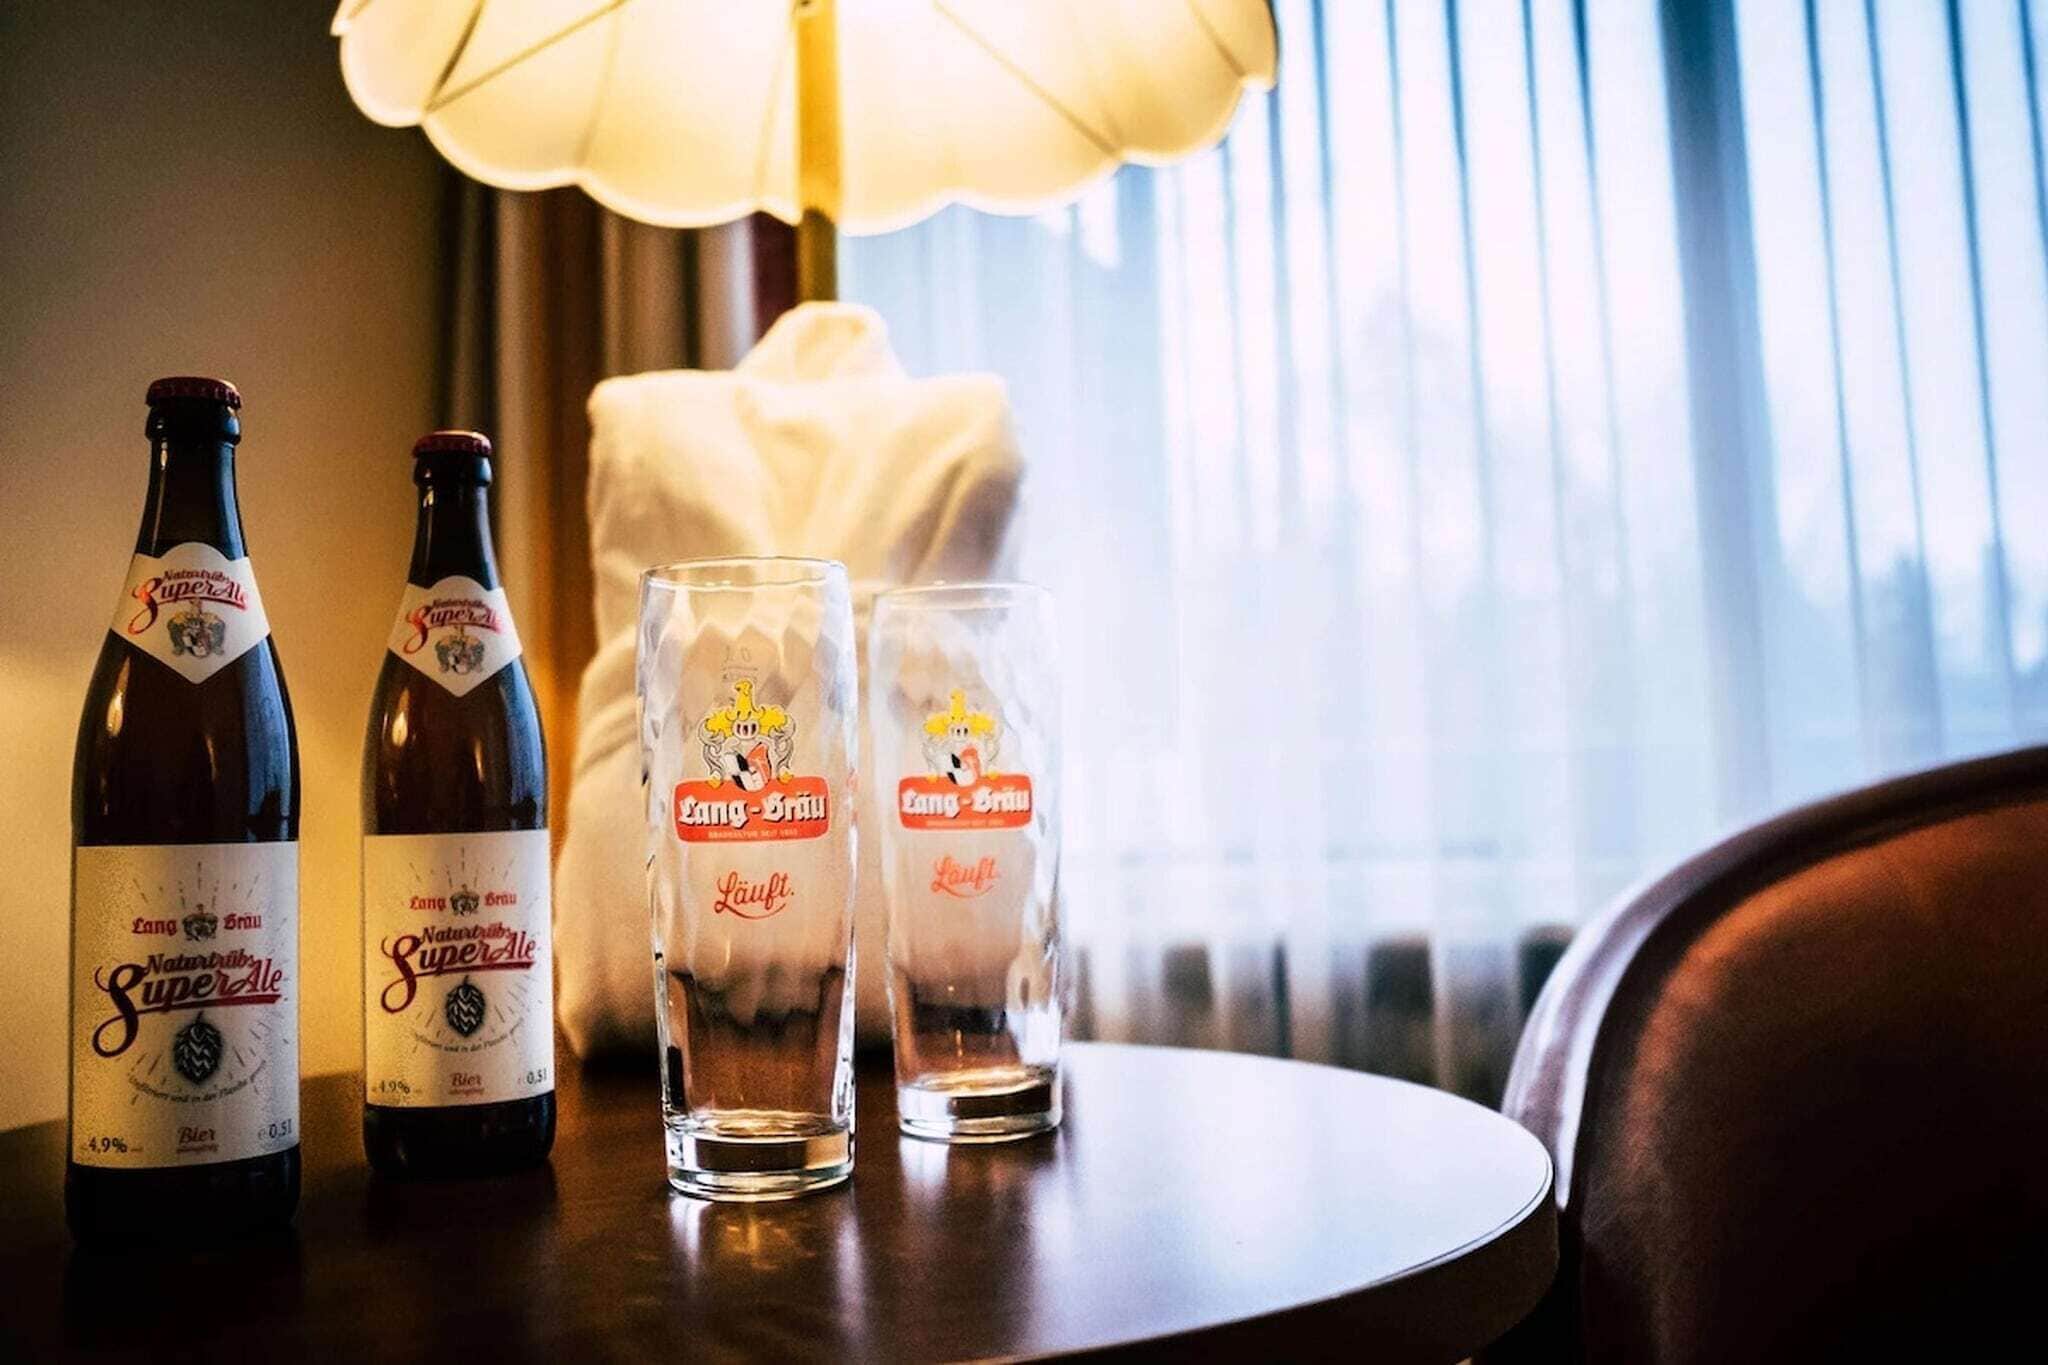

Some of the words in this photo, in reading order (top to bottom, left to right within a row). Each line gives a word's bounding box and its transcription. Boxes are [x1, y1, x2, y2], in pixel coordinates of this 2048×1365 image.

[409, 896, 447, 912] Lang
[131, 916, 178, 935] Lang
[223, 912, 262, 931] Bräu
[451, 1072, 483, 1087] Bier
[177, 1126, 216, 1144] Bier
